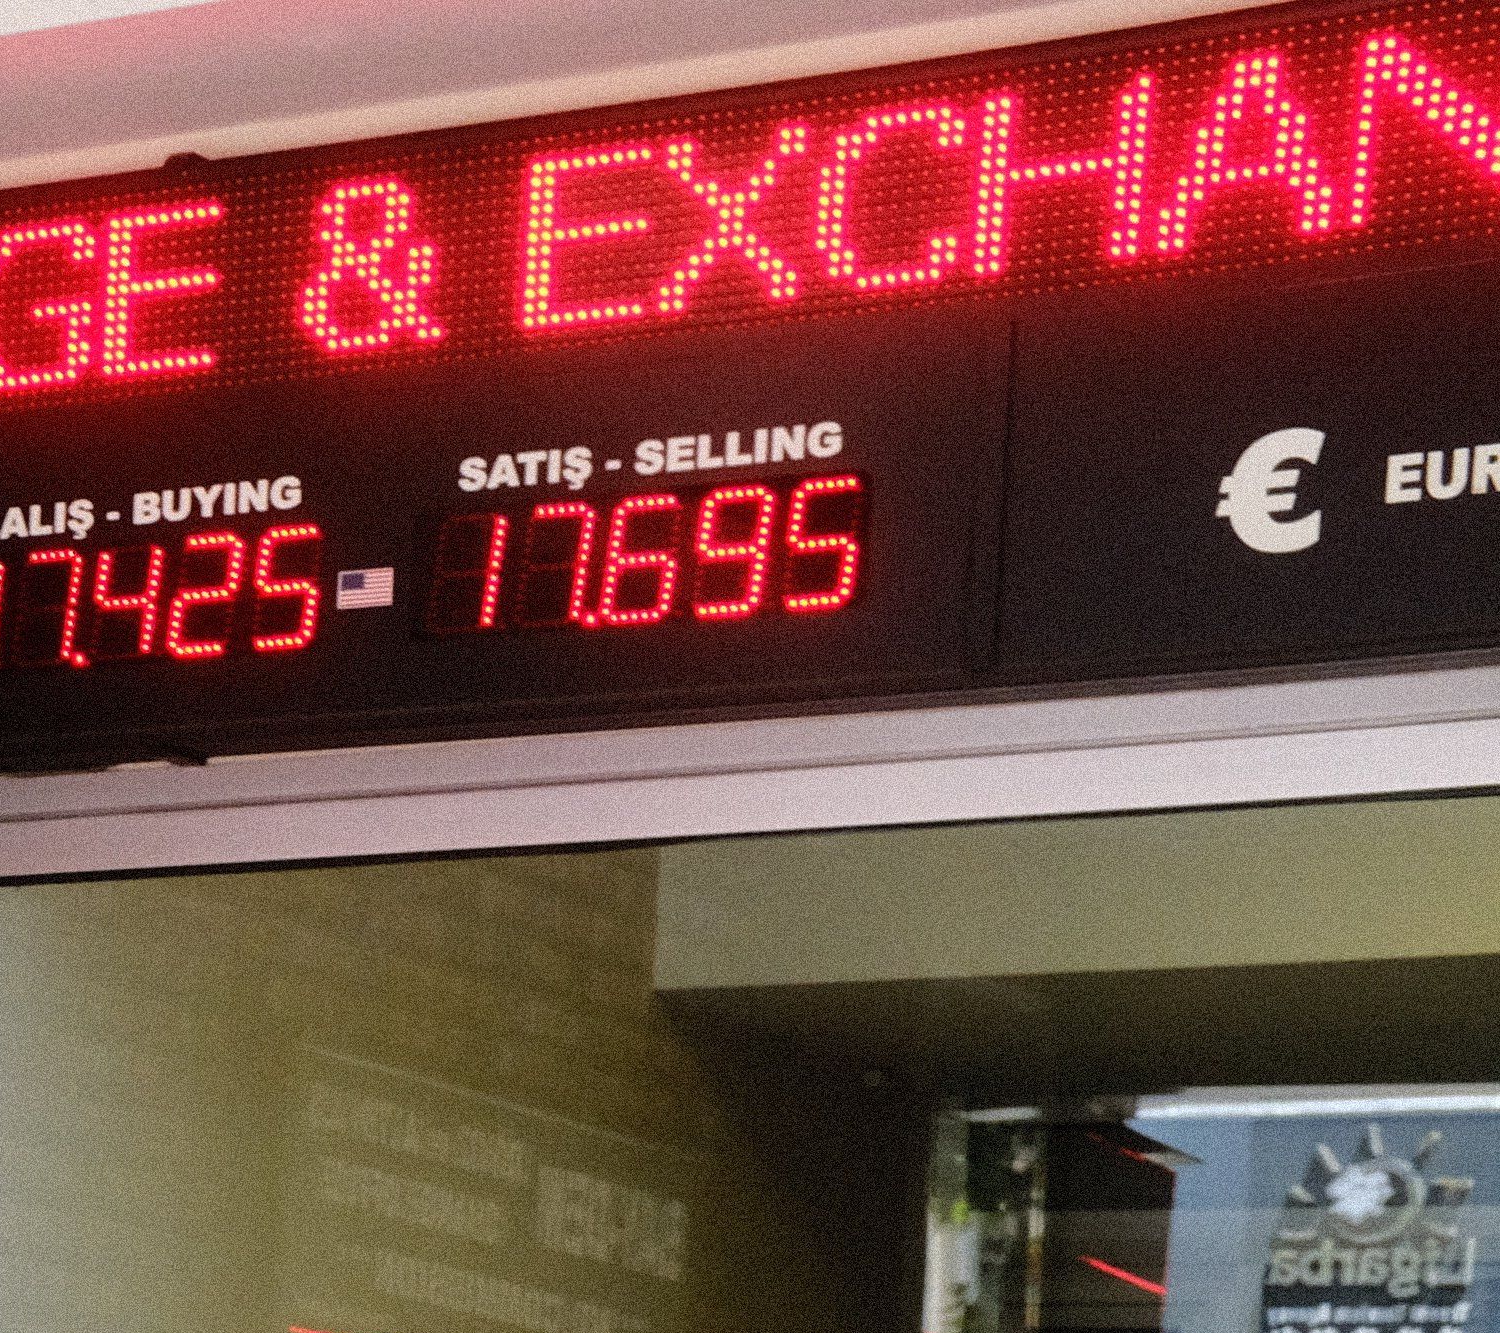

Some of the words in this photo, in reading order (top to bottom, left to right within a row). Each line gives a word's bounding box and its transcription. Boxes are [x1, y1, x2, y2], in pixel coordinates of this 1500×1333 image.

[299, 180, 445, 352] &
[132, 475, 302, 521] BUYING
[458, 445, 593, 492] SATIŞ
[636, 420, 843, 476] SELLING
[1215, 428, 1326, 553] €
[1384, 443, 1500, 504] EUR
[482, 476, 858, 627] 17.695
